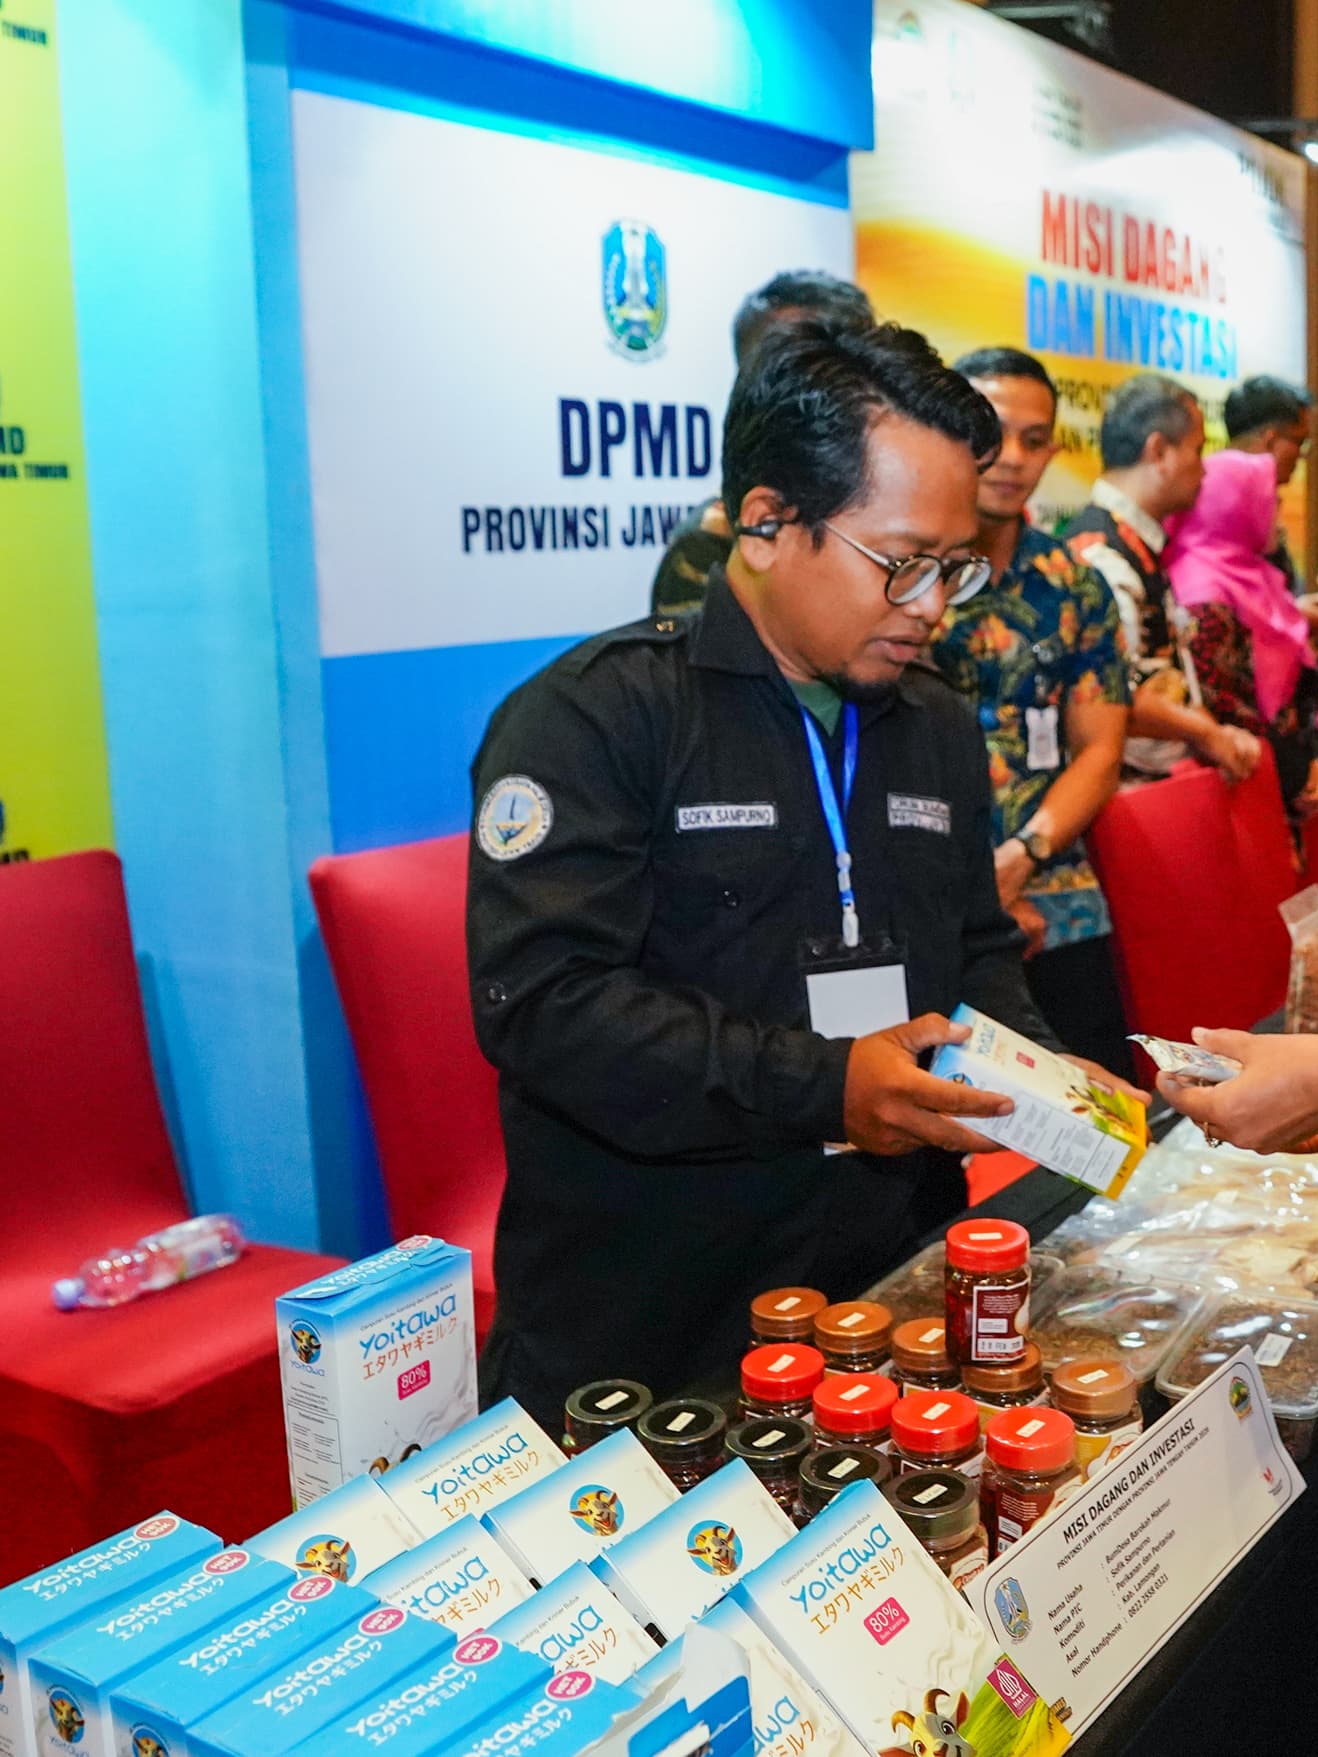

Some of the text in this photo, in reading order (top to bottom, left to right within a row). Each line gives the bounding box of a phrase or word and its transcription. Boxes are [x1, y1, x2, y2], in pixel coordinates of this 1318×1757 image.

[1042, 190, 1112, 278] MISI
[1027, 272, 1238, 379] DAN INVESTASI
[558, 397, 711, 477] DPMD
[462, 504, 697, 552] PROVINSI JAW
[681, 809, 712, 826] SOFIK
[401, 1364, 427, 1389] 80%
[441, 1450, 539, 1521] エタワヤギミルク
[1062, 1513, 1089, 1545] MISI
[1088, 1477, 1130, 1522] DAGANG
[1128, 1460, 1150, 1492] DAN
[1150, 1417, 1196, 1467] INVESTASI
[1057, 1543, 1083, 1570] PROVINSI
[1082, 1530, 1097, 1548] JAWA
[1058, 1619, 1086, 1649] Komoditi
[1115, 1562, 1143, 1592] Perikanan
[1142, 1551, 1153, 1567] dan
[1151, 1529, 1176, 1556] Pertanian
[811, 1547, 904, 1635] エタワヤギミルク
[869, 1603, 900, 1633] 80%
[1047, 1600, 1066, 1620] Nama
[1064, 1583, 1084, 1604] Usaha
[1053, 1615, 1072, 1635] Nama
[1069, 1602, 1084, 1620] PIC
[1110, 1559, 1126, 1579] Sofik
[1065, 1646, 1080, 1664] Asal
[1121, 1590, 1136, 1605] Kab.
[1134, 1563, 1161, 1592] Lamongan
[1071, 1655, 1092, 1678] Nomor
[1090, 1622, 1123, 1658] Handphone
[1127, 1599, 1144, 1618] 0822
[1153, 1573, 1169, 1591] 0321
